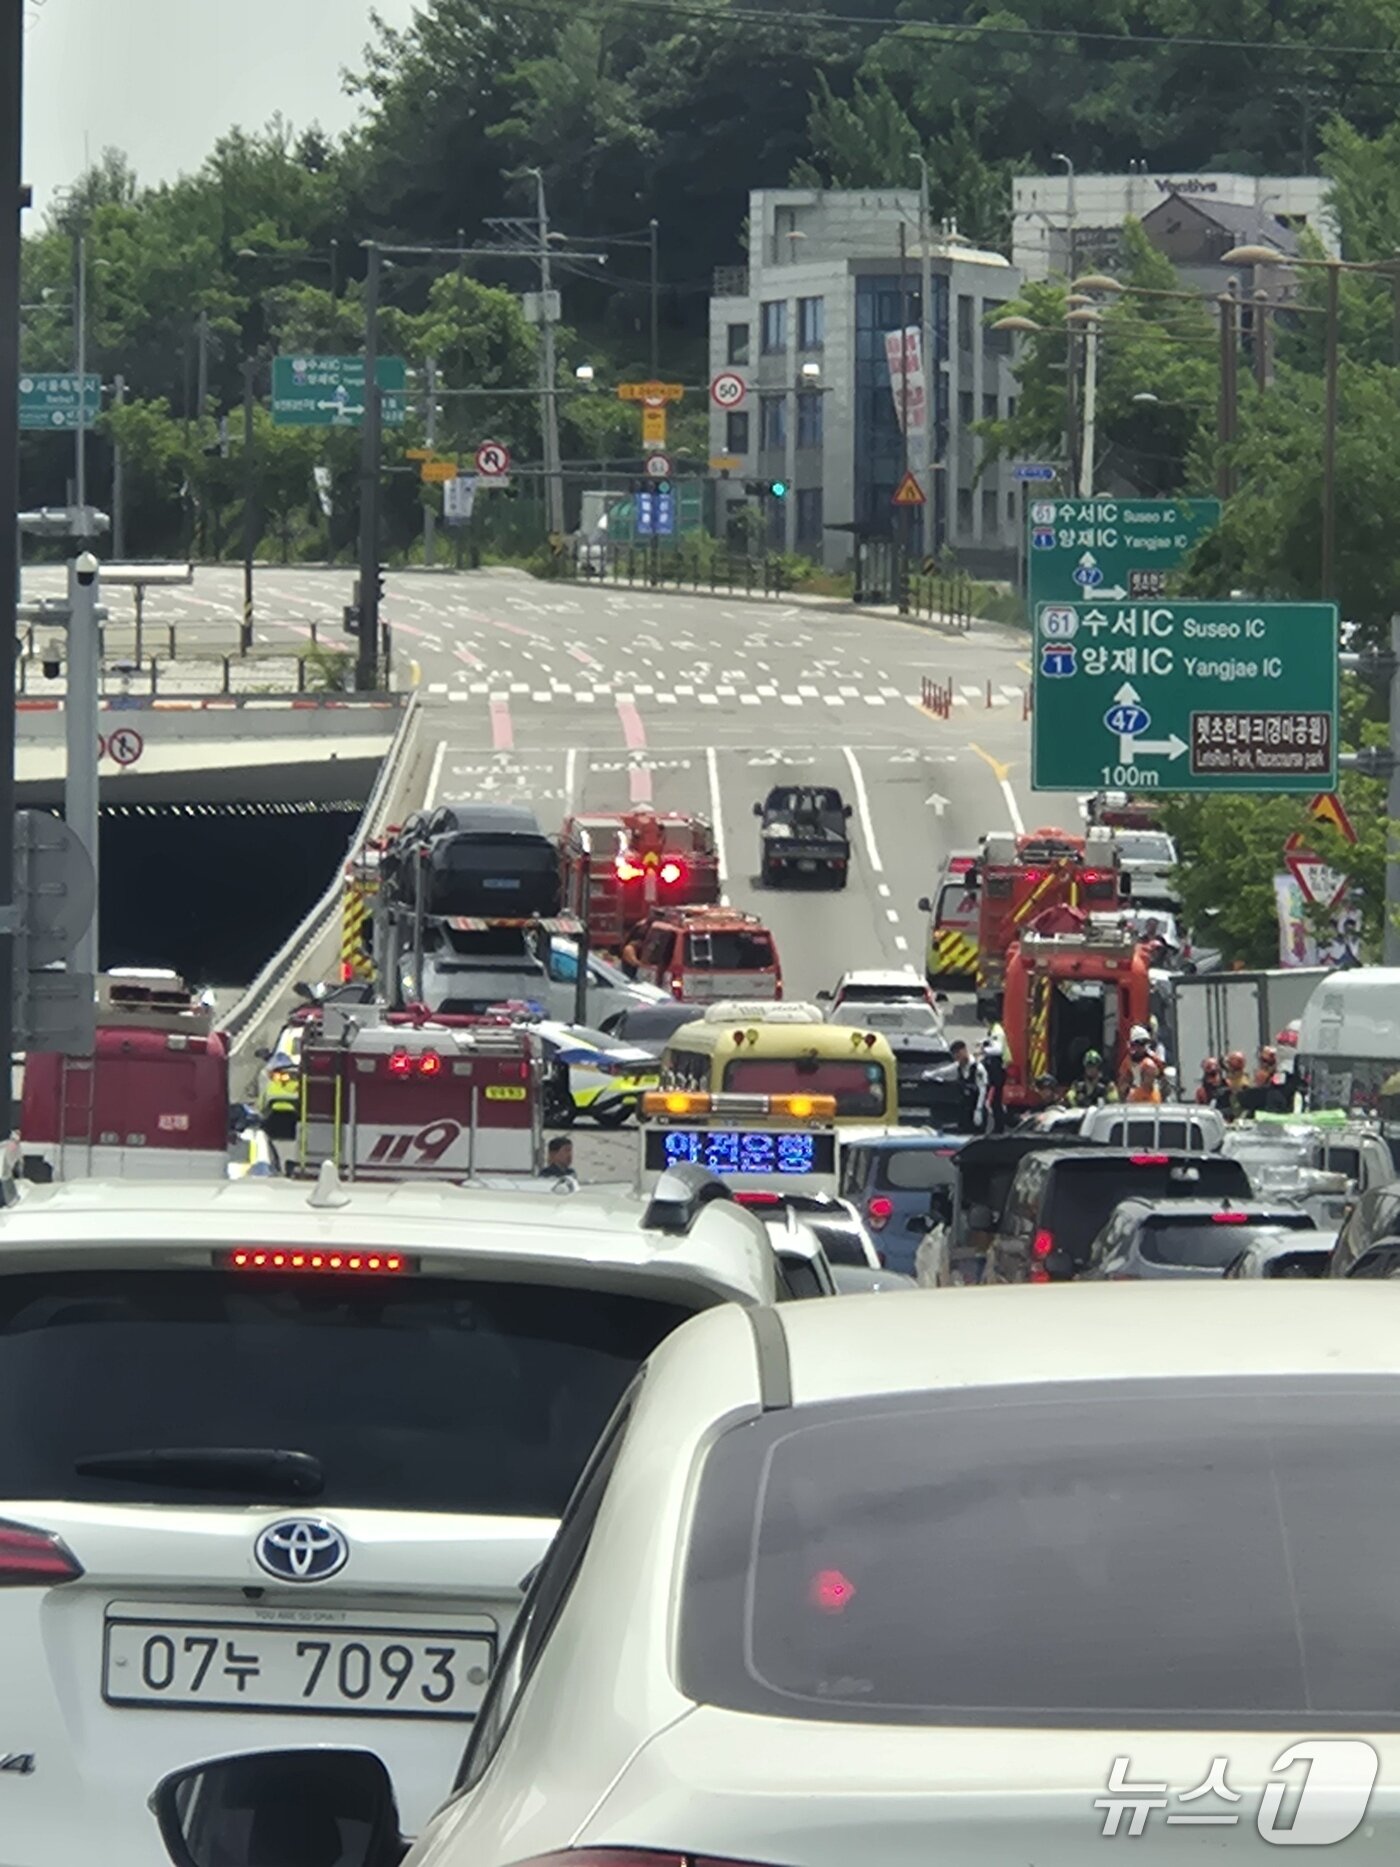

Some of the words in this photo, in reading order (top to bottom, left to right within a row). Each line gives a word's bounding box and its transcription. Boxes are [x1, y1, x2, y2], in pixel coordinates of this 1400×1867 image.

[719, 383, 739, 398] 50
[1058, 503, 1118, 523] 수서IC
[1058, 528, 1118, 548] 양재IC
[1049, 613, 1071, 634] 61
[1081, 608, 1174, 637] 수서IC
[1183, 619, 1241, 637] Suseo
[1246, 619, 1266, 637] IC
[1053, 656, 1063, 672] 1
[1081, 646, 1174, 676] 양재IC
[1183, 658, 1258, 681] Yangjae
[1263, 658, 1283, 677] IC
[1111, 710, 1140, 730] 47
[1100, 766, 1159, 786] 100m
[366, 1118, 462, 1164] 119
[142, 1634, 260, 1692] 07누
[296, 1641, 456, 1703] 7093
